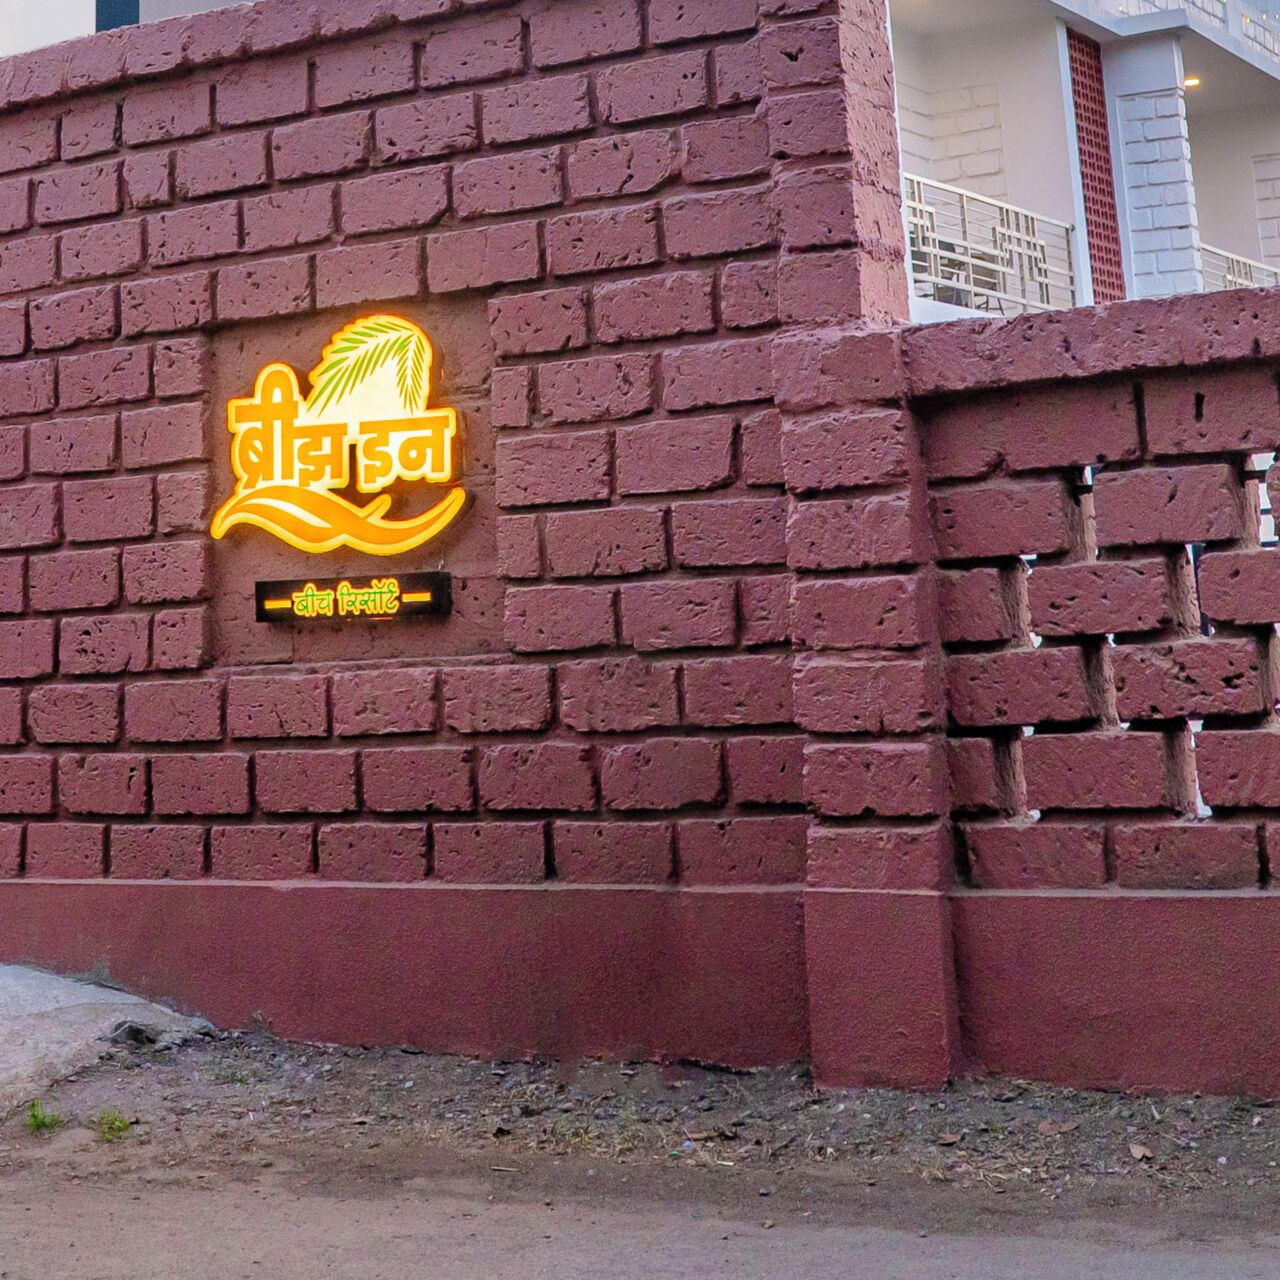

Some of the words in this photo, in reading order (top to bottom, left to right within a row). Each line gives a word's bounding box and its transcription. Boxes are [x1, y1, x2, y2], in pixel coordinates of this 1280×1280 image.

[235, 368, 348, 489] ब्रीझ
[358, 415, 450, 484] इन
[292, 581, 334, 617] बीच
